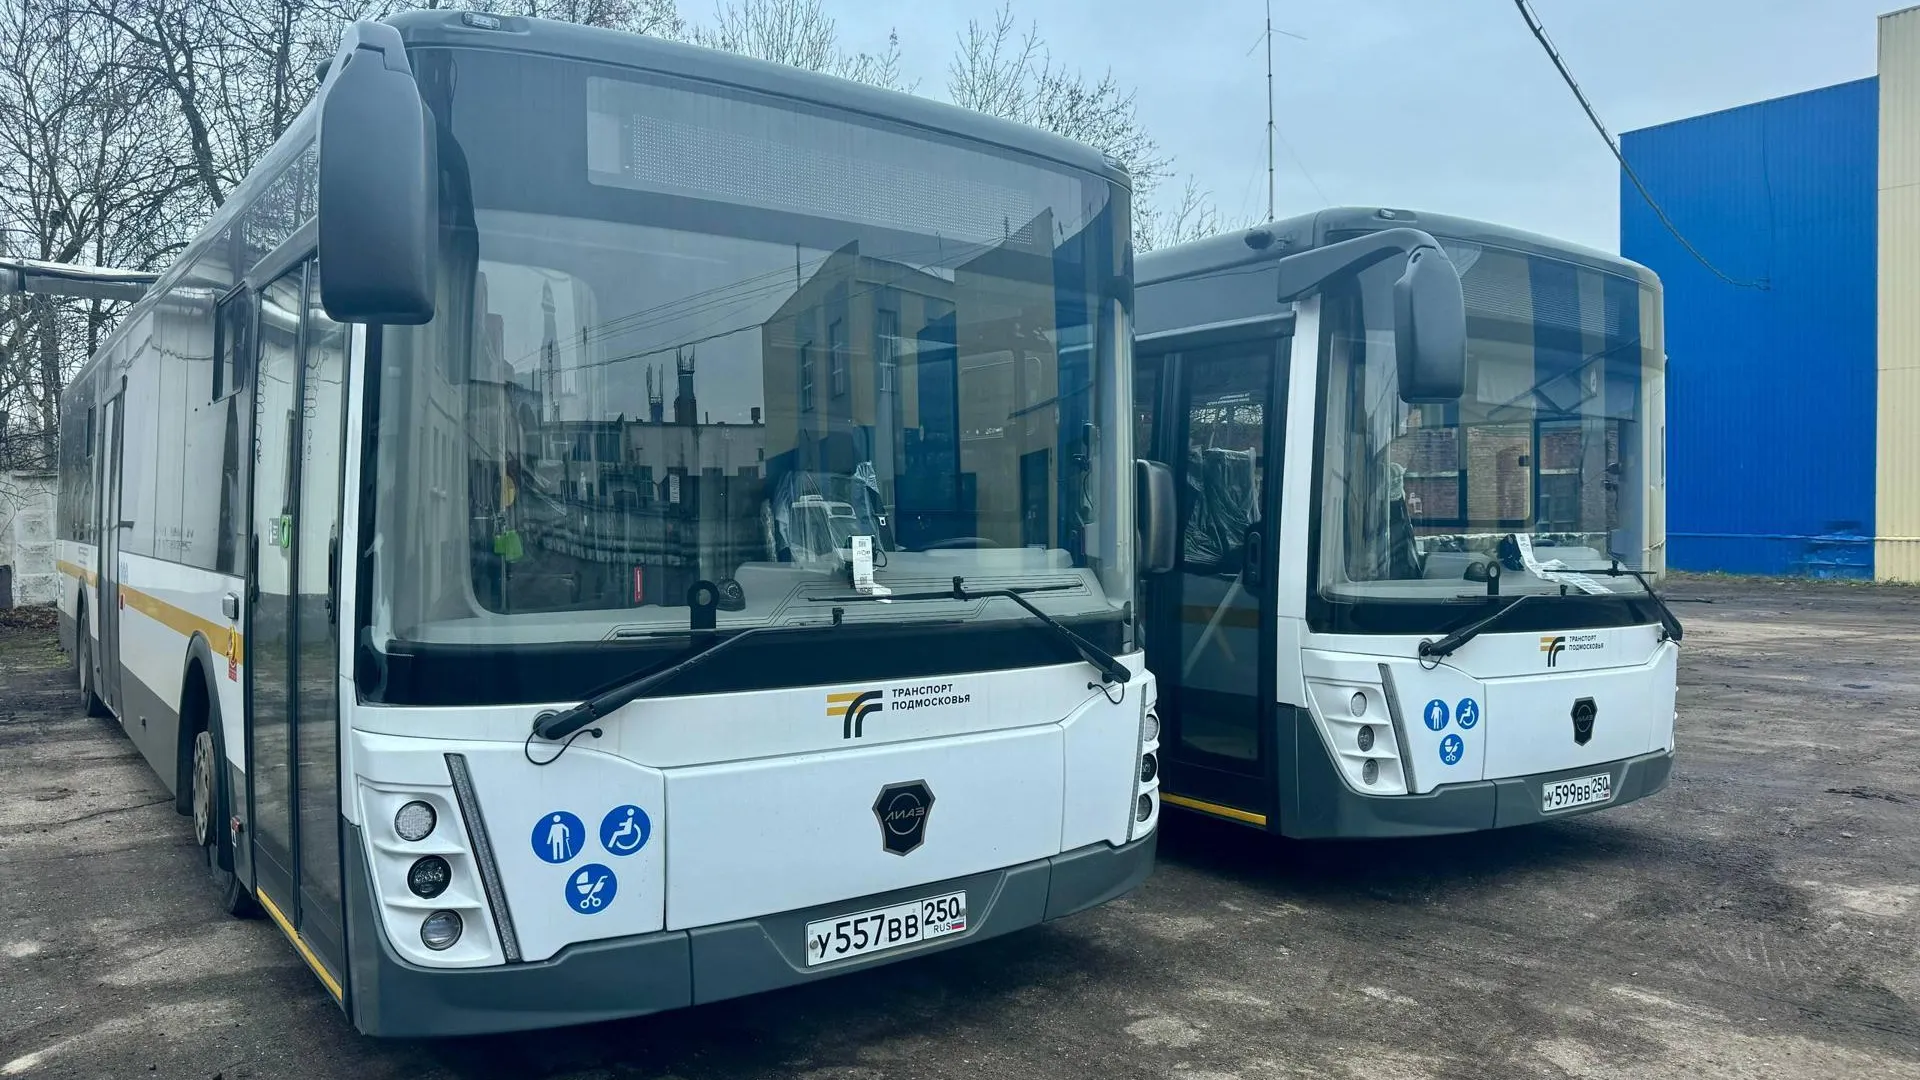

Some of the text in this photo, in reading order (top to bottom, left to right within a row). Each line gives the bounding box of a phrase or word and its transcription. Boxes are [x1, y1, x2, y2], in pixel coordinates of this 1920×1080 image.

[1569, 634, 1597, 642] ТРАНСПОРТ
[1568, 642, 1604, 651] ПОДМОСКОВЬЯ
[892, 684, 953, 698] ТРАНСПОРТ
[892, 694, 970, 710] ПОДМОСКОВЬЯ
[1592, 776, 1608, 793] 250
[885, 806, 925, 822] ЛИАЗ
[817, 896, 960, 958] У557ВВ 250
[933, 922, 951, 934] RUS
